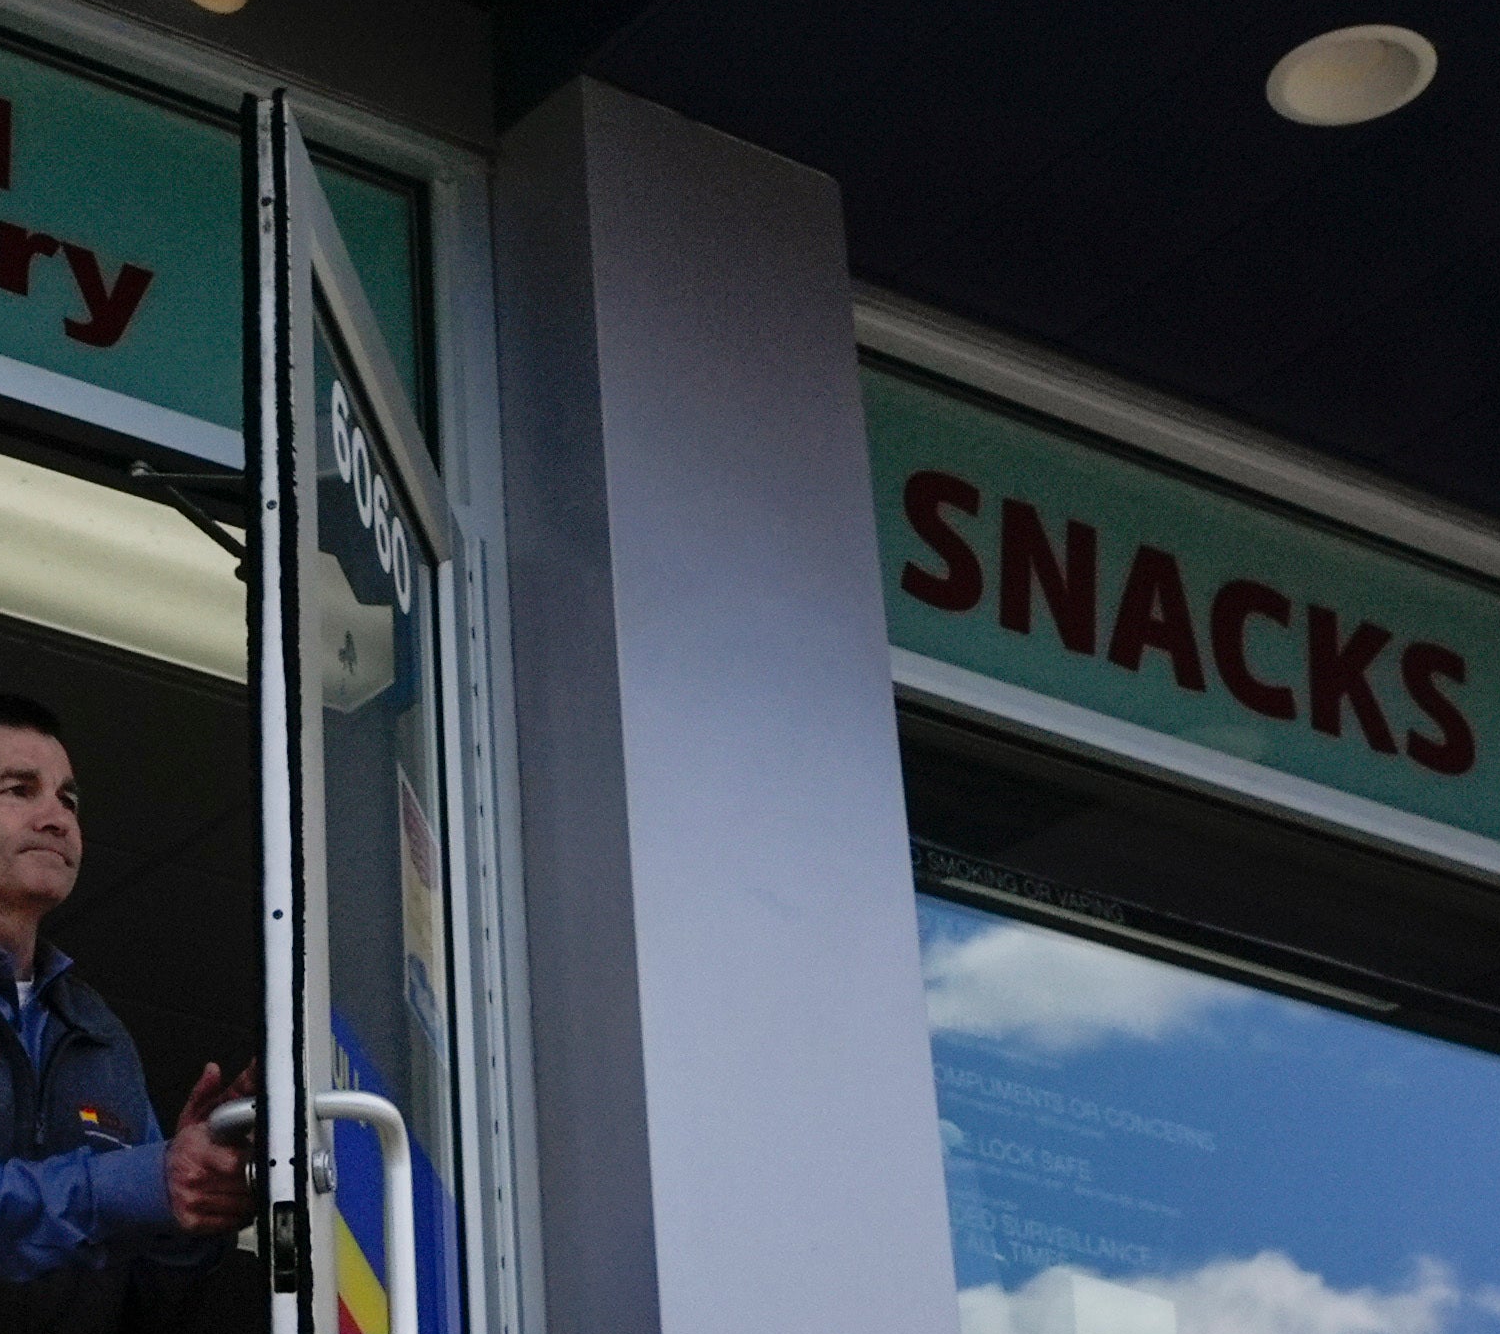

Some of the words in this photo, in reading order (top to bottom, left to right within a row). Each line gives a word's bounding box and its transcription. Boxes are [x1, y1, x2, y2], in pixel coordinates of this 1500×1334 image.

[331, 379, 412, 615] 6060
[900, 468, 1476, 778] SNACKS
[927, 849, 1019, 894] SMOKING
[1023, 878, 1052, 901] OR
[1056, 888, 1126, 925] VAPING
[934, 1062, 1065, 1114] OMPLIMENTS
[1069, 1098, 1101, 1122] OR
[979, 1138, 1035, 1167] LOCK
[1041, 1149, 1093, 1183] SAFE
[951, 1201, 997, 1231] DEO
[1001, 1213, 1152, 1266] SURVEILLANCE
